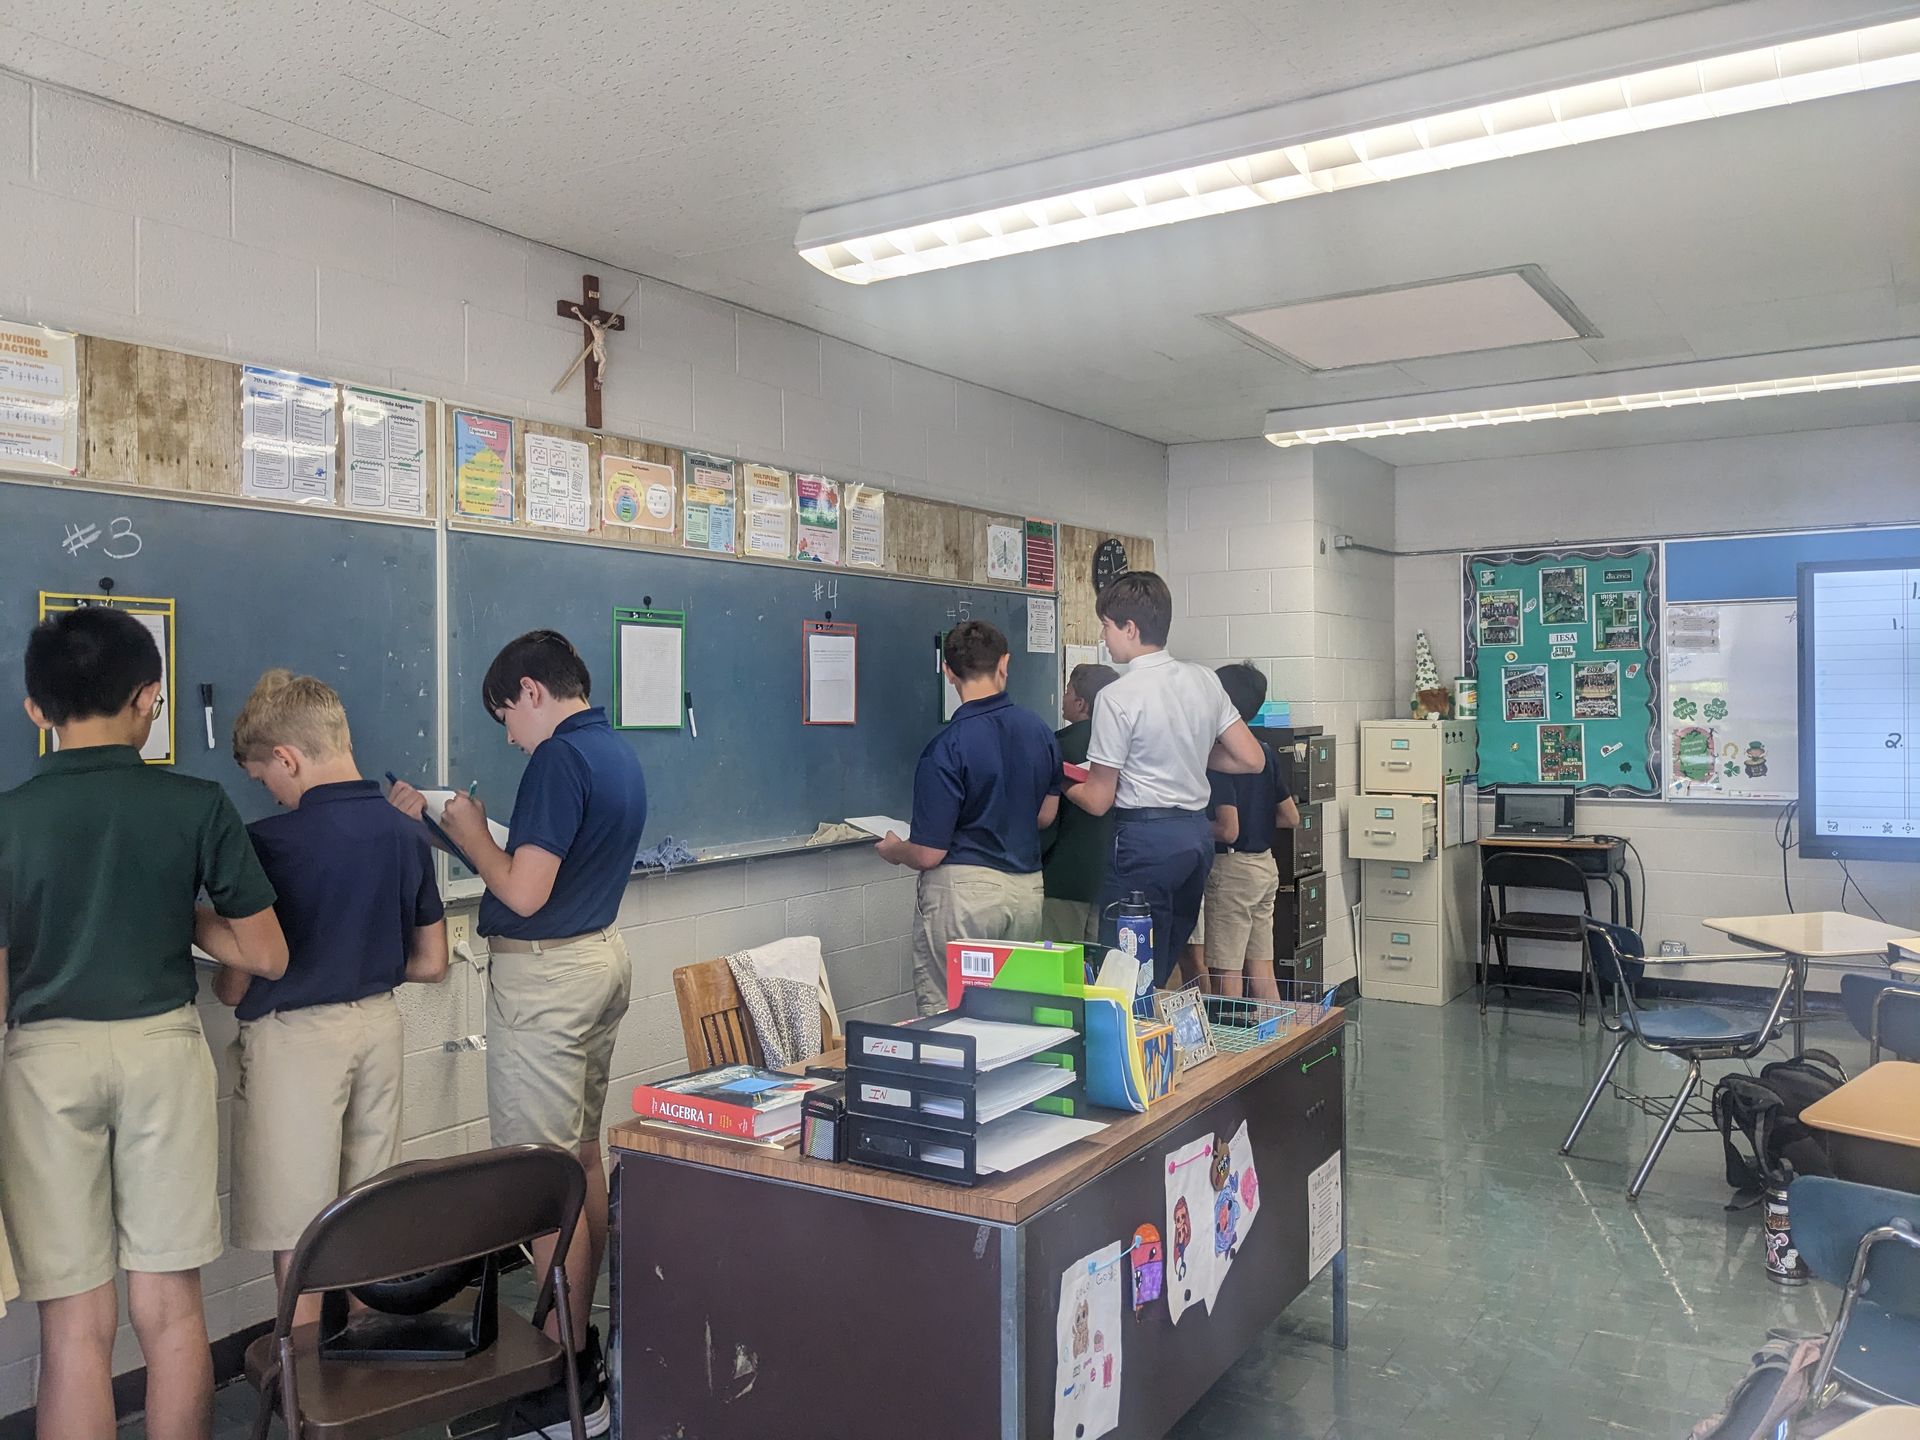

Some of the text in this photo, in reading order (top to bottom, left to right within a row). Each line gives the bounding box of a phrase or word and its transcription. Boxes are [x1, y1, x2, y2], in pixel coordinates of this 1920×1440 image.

[0, 333, 41, 347] IVIDING
[395, 401, 414, 411] Algebra
[753, 472, 780, 483] MULTIPLYING
[756, 479, 780, 489] FRACTIONS
[62, 516, 142, 559] #3
[812, 579, 838, 609] #4
[946, 600, 974, 622] #5
[1892, 618, 1904, 630] 1.
[1556, 634, 1576, 642] IESA
[1885, 732, 1904, 749] 2.
[871, 1041, 897, 1054] FILE
[869, 1089, 888, 1100] IN
[659, 1101, 704, 1123] ALGEBRA
[708, 1113, 713, 1125] 1
